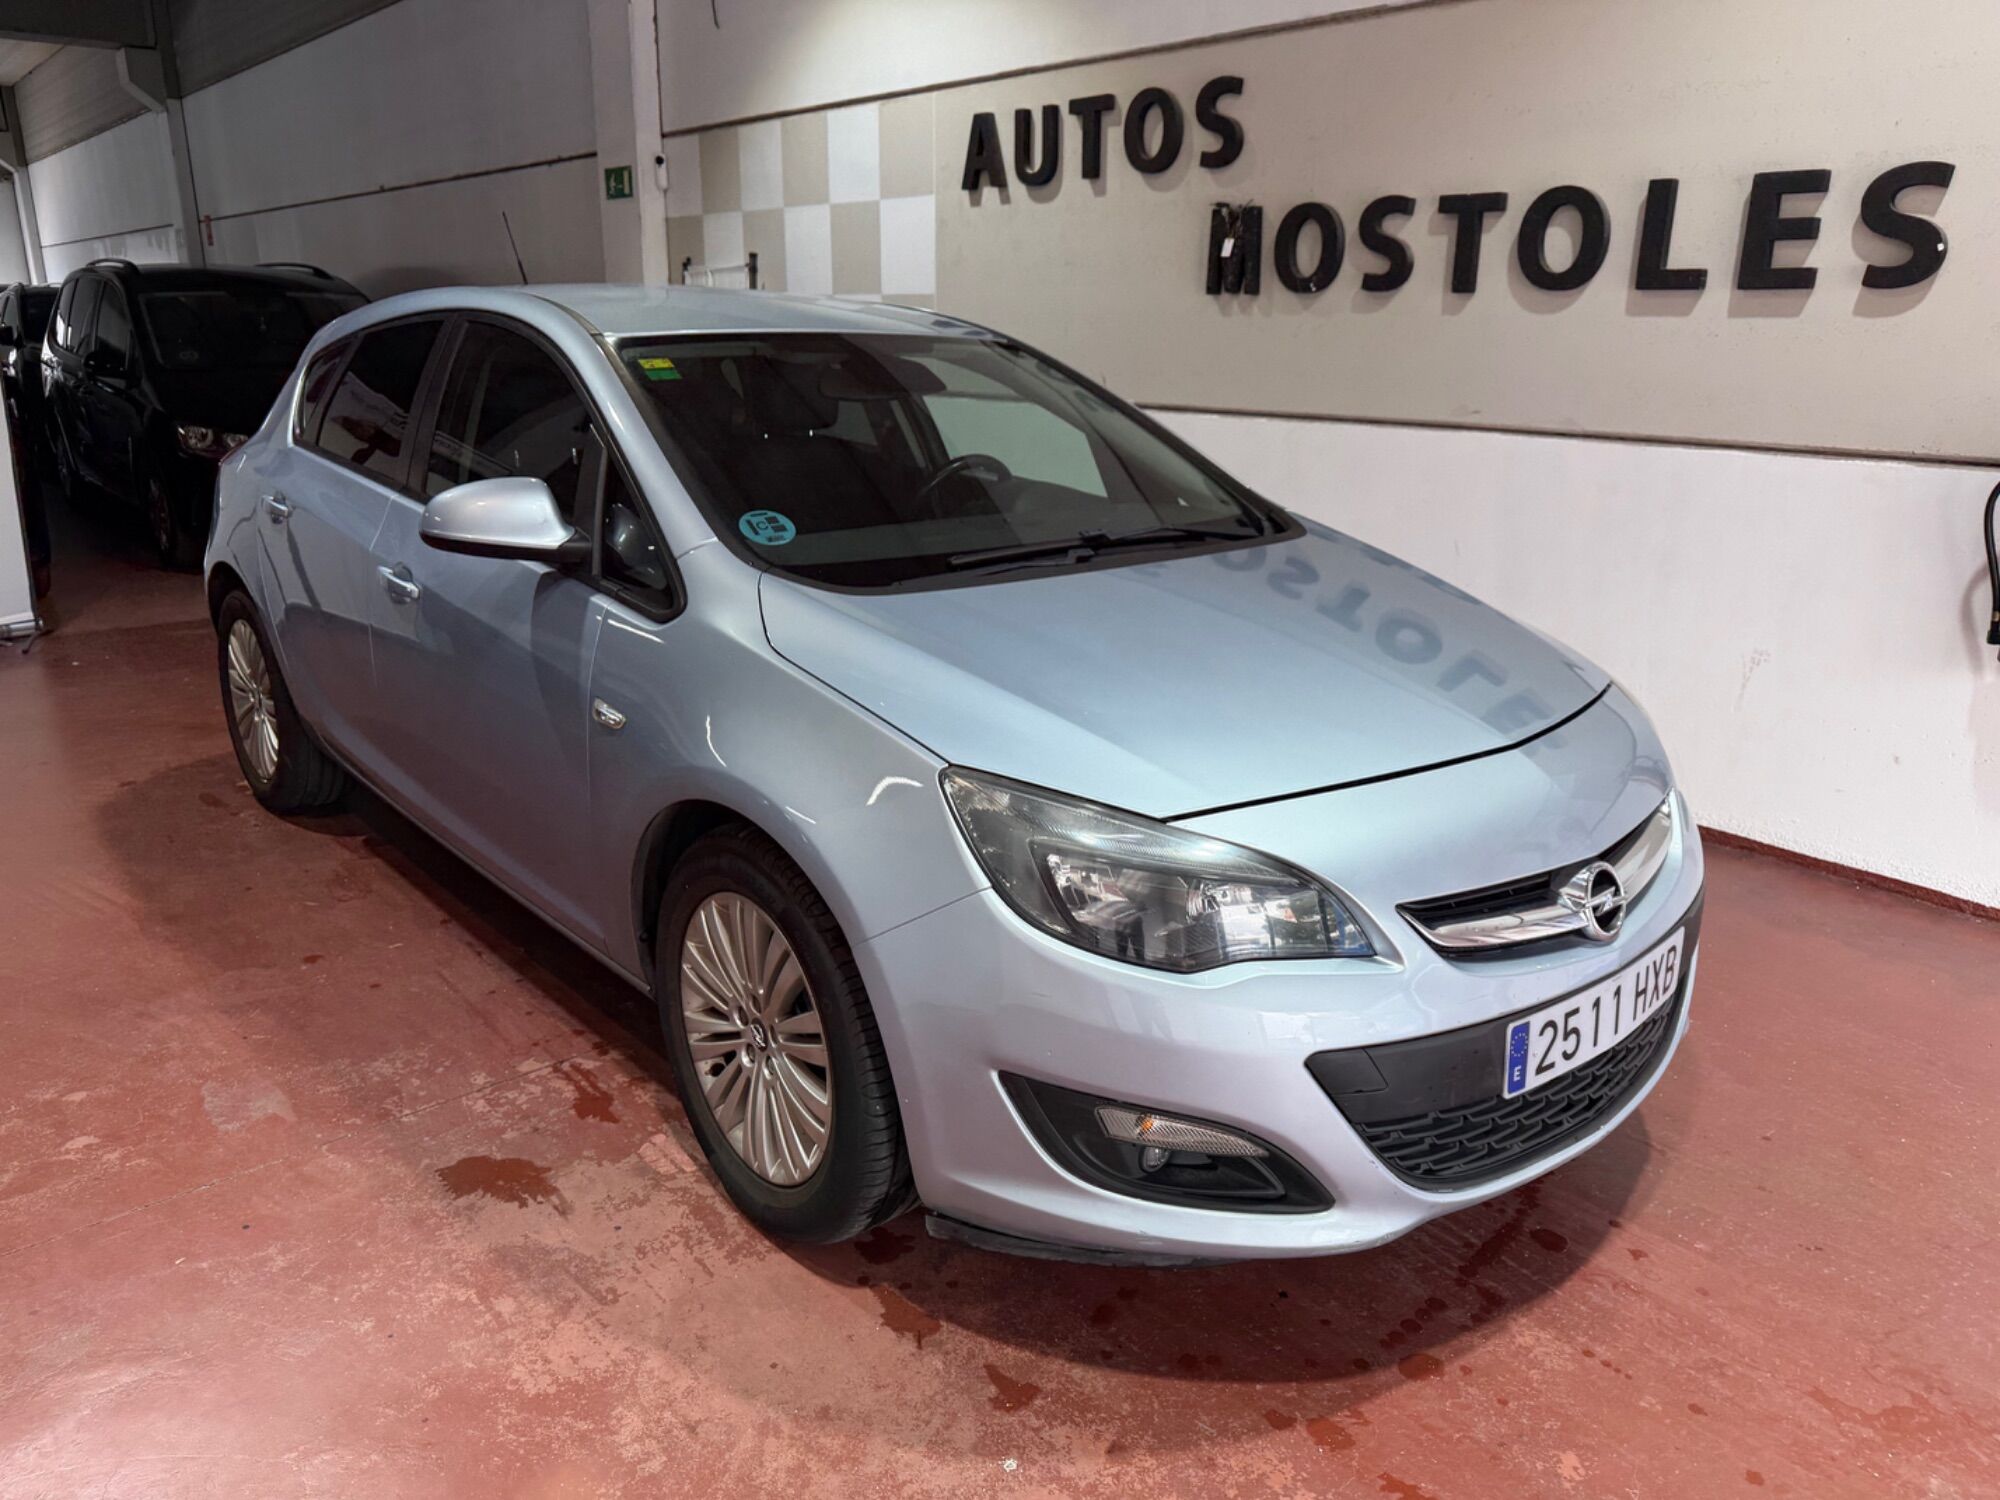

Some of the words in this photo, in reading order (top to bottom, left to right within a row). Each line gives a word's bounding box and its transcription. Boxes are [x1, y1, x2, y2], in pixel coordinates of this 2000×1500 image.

[962, 76, 1244, 192] AUTOS
[1206, 160, 1956, 296] MOSTOLES
[1535, 985, 1622, 1076] 2511
[1633, 945, 1677, 1021] HXB
[1513, 1065, 1522, 1081] E
